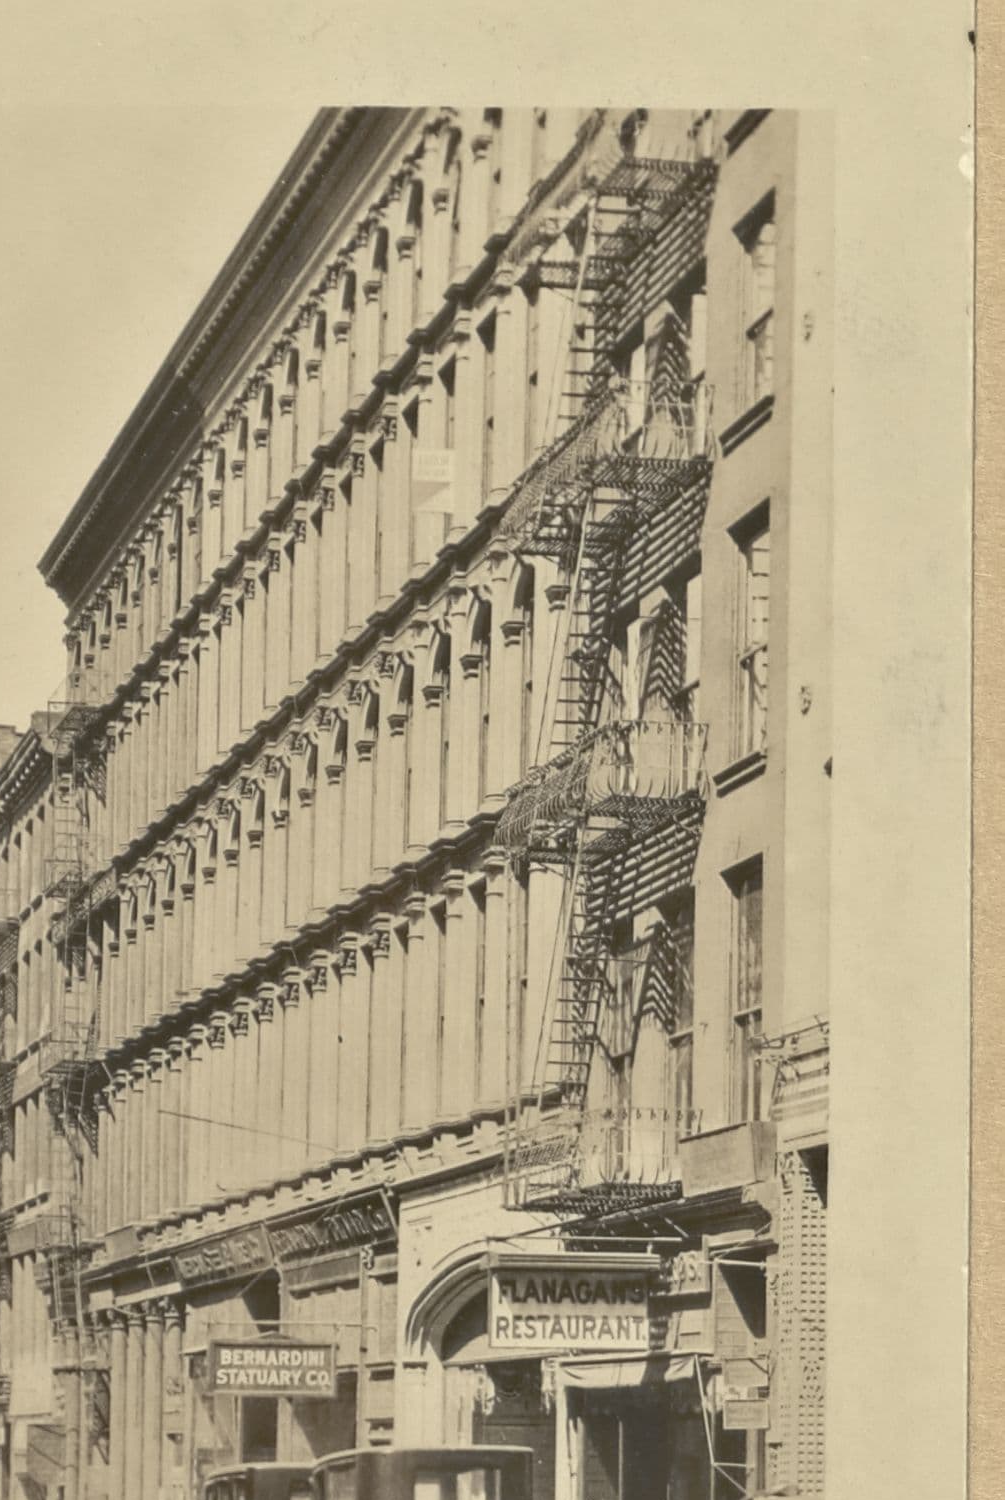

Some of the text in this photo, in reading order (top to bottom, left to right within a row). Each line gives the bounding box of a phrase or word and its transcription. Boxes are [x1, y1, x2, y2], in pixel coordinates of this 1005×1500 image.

[496, 1314, 647, 1341] RESTAURANT.
[220, 1349, 325, 1366] BERNARDINI
[216, 1369, 302, 1386] STATUARY
